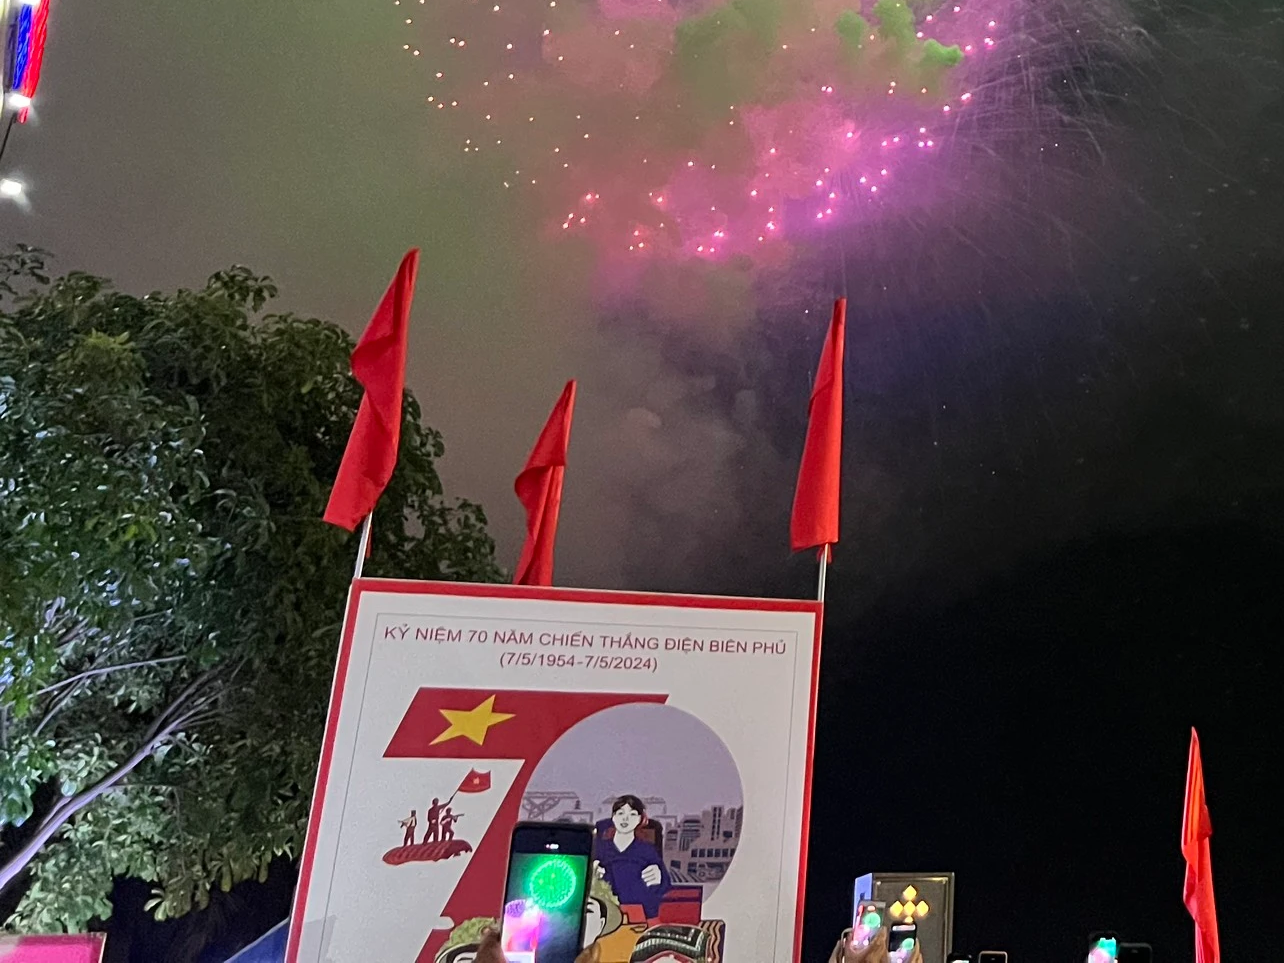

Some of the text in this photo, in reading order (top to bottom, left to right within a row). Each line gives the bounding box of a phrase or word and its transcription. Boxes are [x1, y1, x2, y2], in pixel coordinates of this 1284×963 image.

[383, 623, 787, 655] KỶ NIỆM 70 NĂM CHIẾN THẮNG ĐIỆN BIÊN PHỦ
[499, 652, 659, 674] (7/5/1954-7/5/2024)
